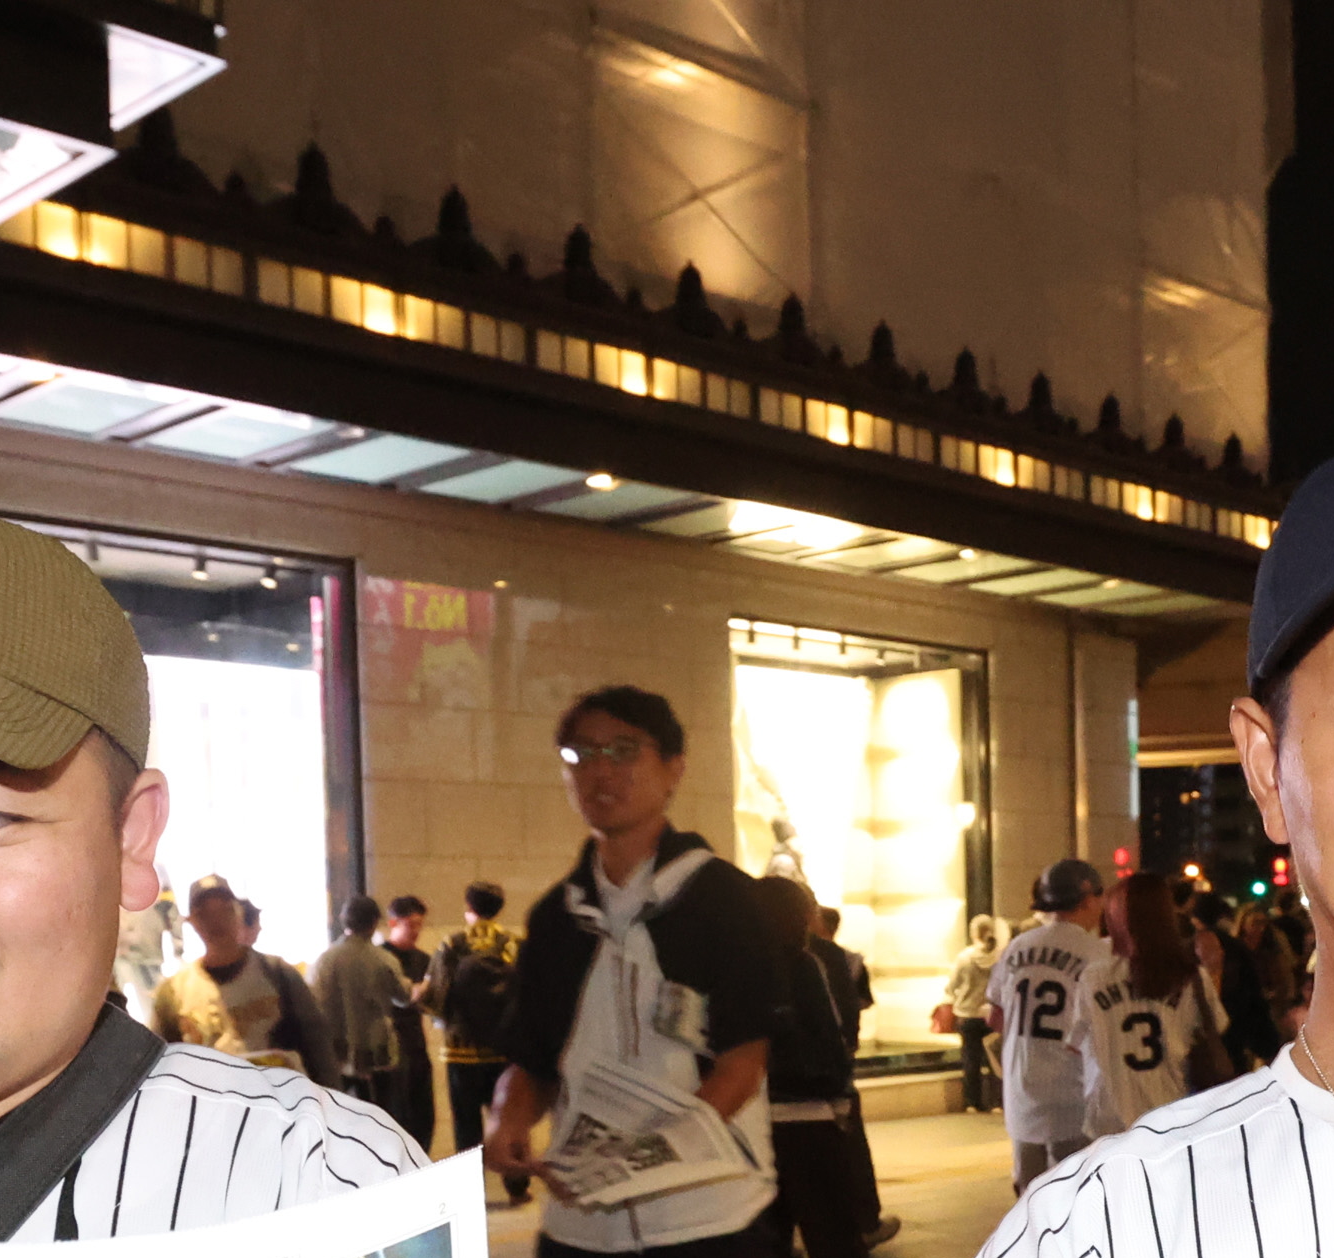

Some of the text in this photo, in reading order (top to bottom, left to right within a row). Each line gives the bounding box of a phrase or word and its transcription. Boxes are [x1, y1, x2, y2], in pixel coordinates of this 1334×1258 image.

[1016, 978, 1066, 1040] 12
[1122, 1012, 1164, 1071] 3
[438, 1202, 447, 1215] 2
